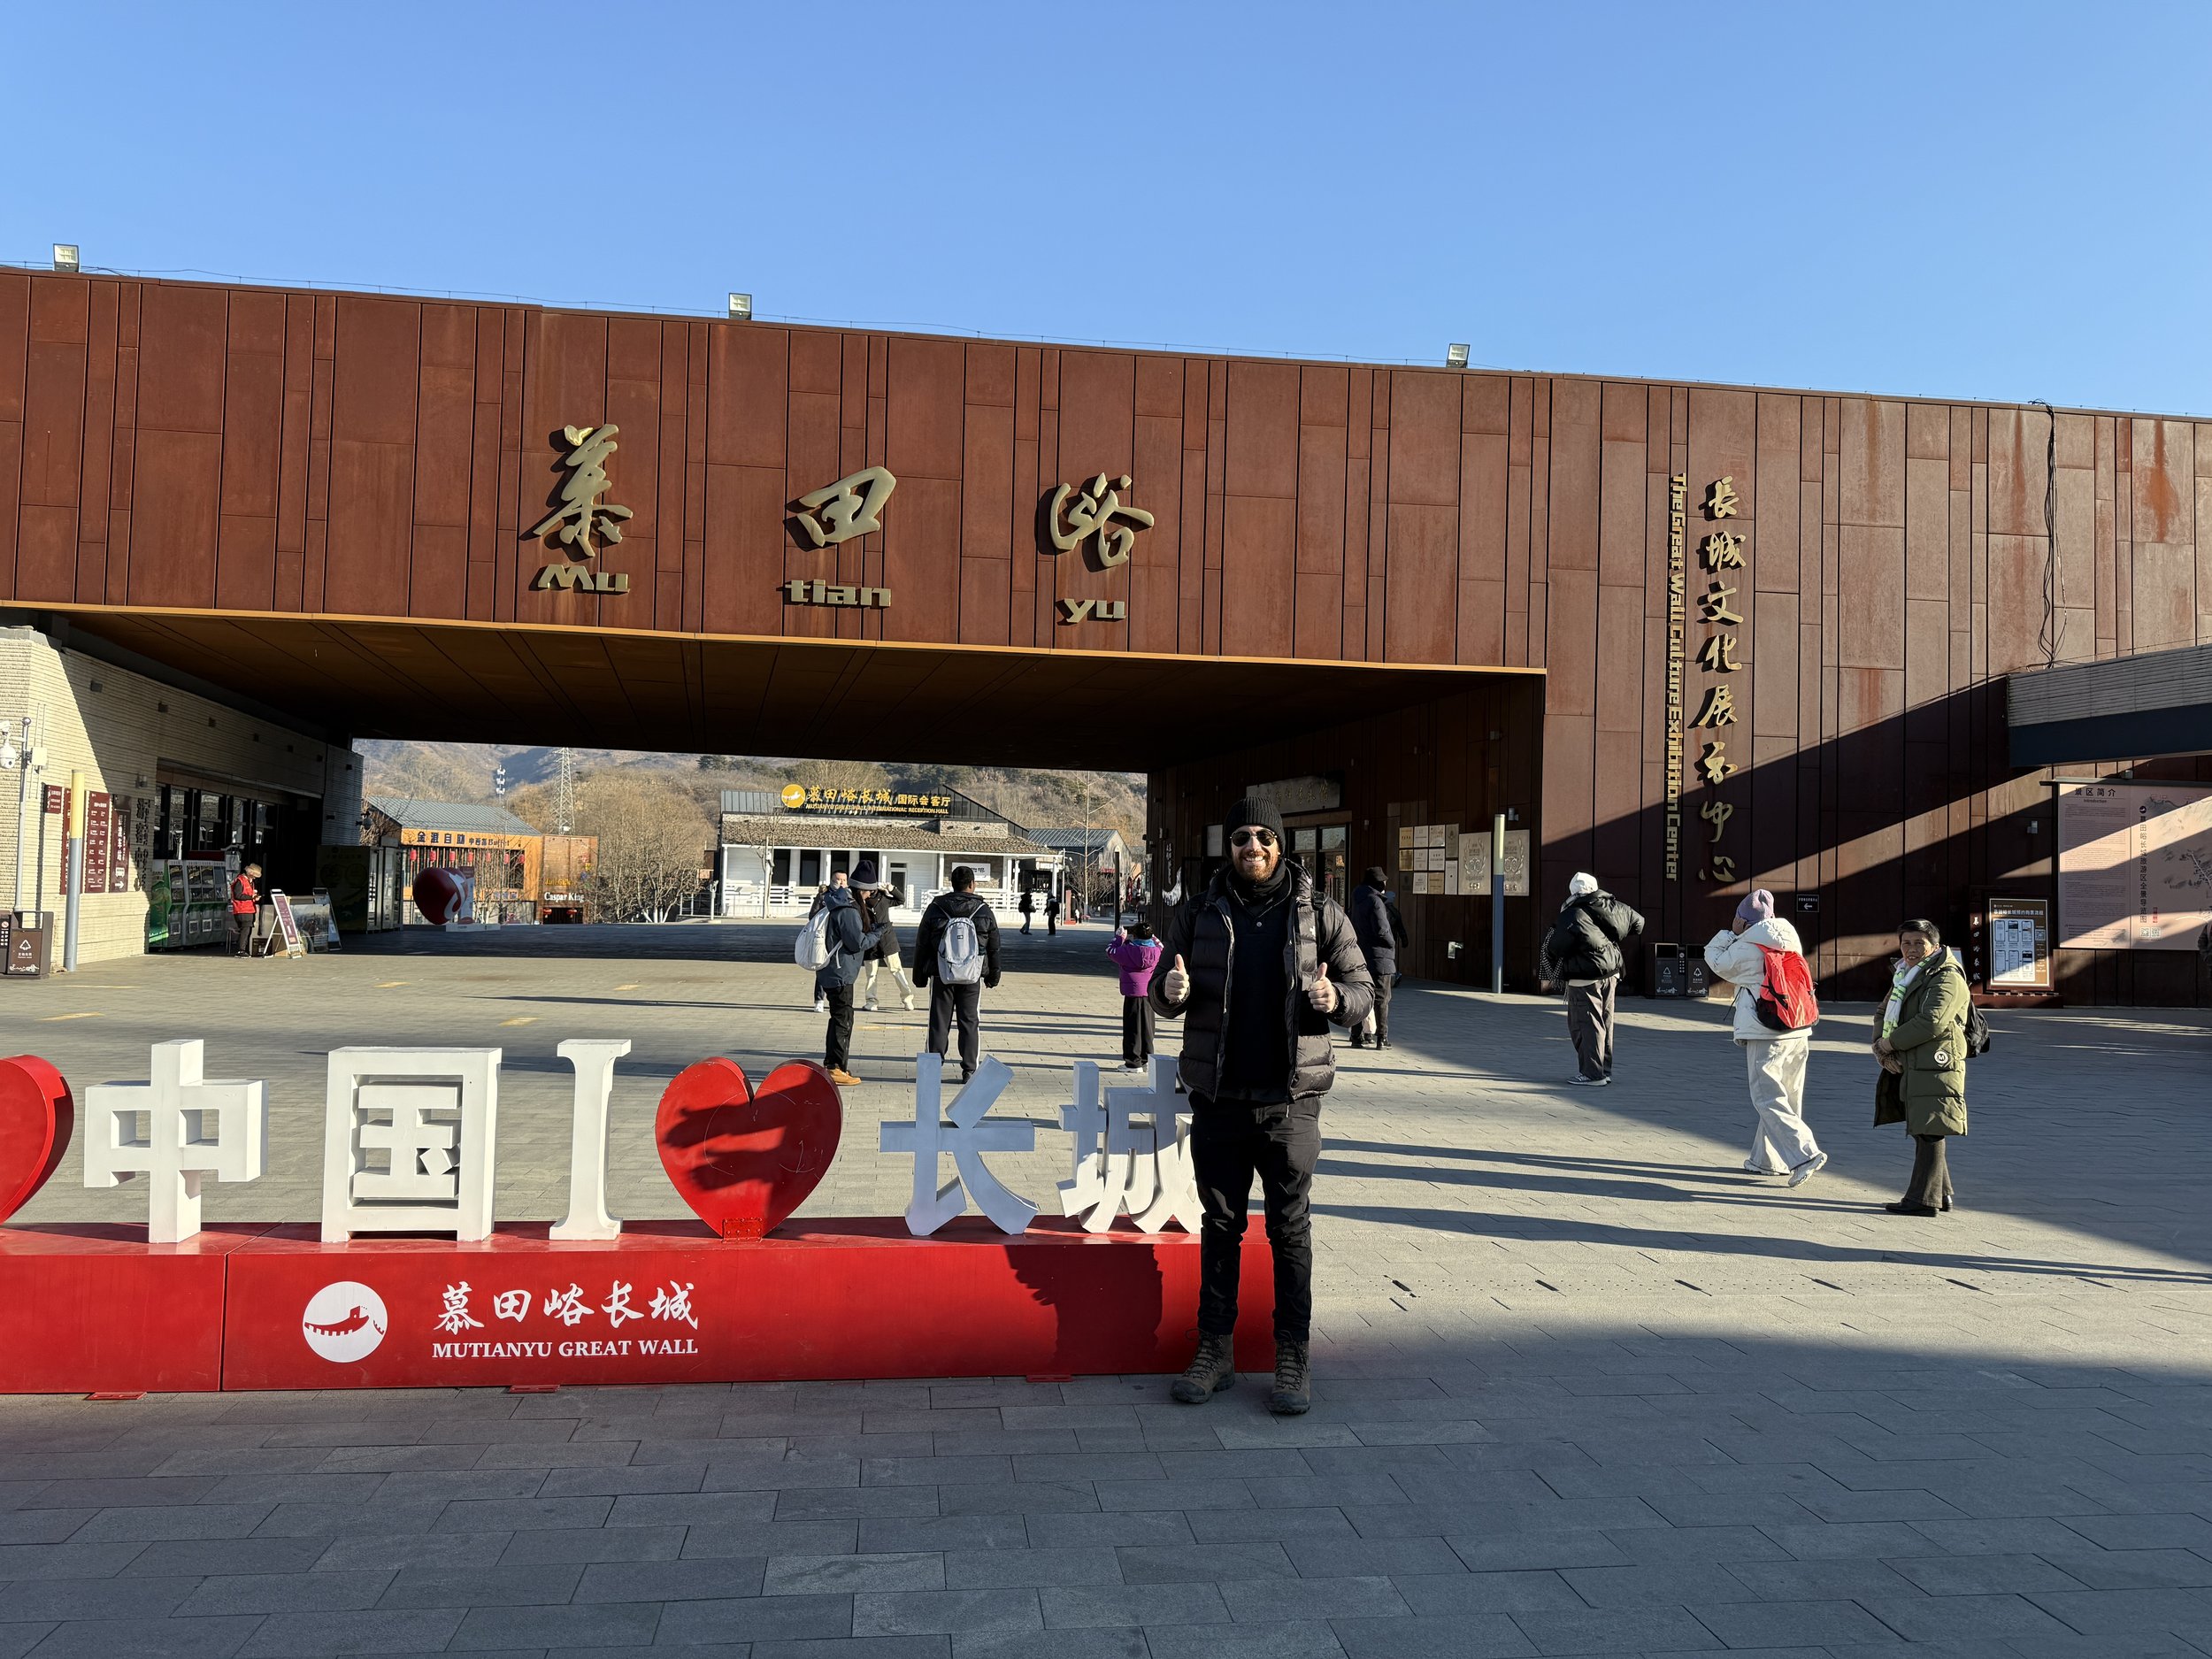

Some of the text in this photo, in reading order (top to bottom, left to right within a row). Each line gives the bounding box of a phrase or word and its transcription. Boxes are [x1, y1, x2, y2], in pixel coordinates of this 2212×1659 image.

[537, 564, 1126, 623] Mu tian yu
[1666, 473, 1687, 882] The Great Wall Culture Exhibition Center
[806, 784, 951, 808] 慕田峪长城 国际会客厅
[2075, 787, 2116, 797] 景区简介
[544, 892, 584, 902] Caspar King
[83, 1038, 1207, 1244] 中国 I 长城
[433, 1279, 698, 1335] 慕田峪长城
[432, 1339, 698, 1359] MUTIANYU GREAT WALL
